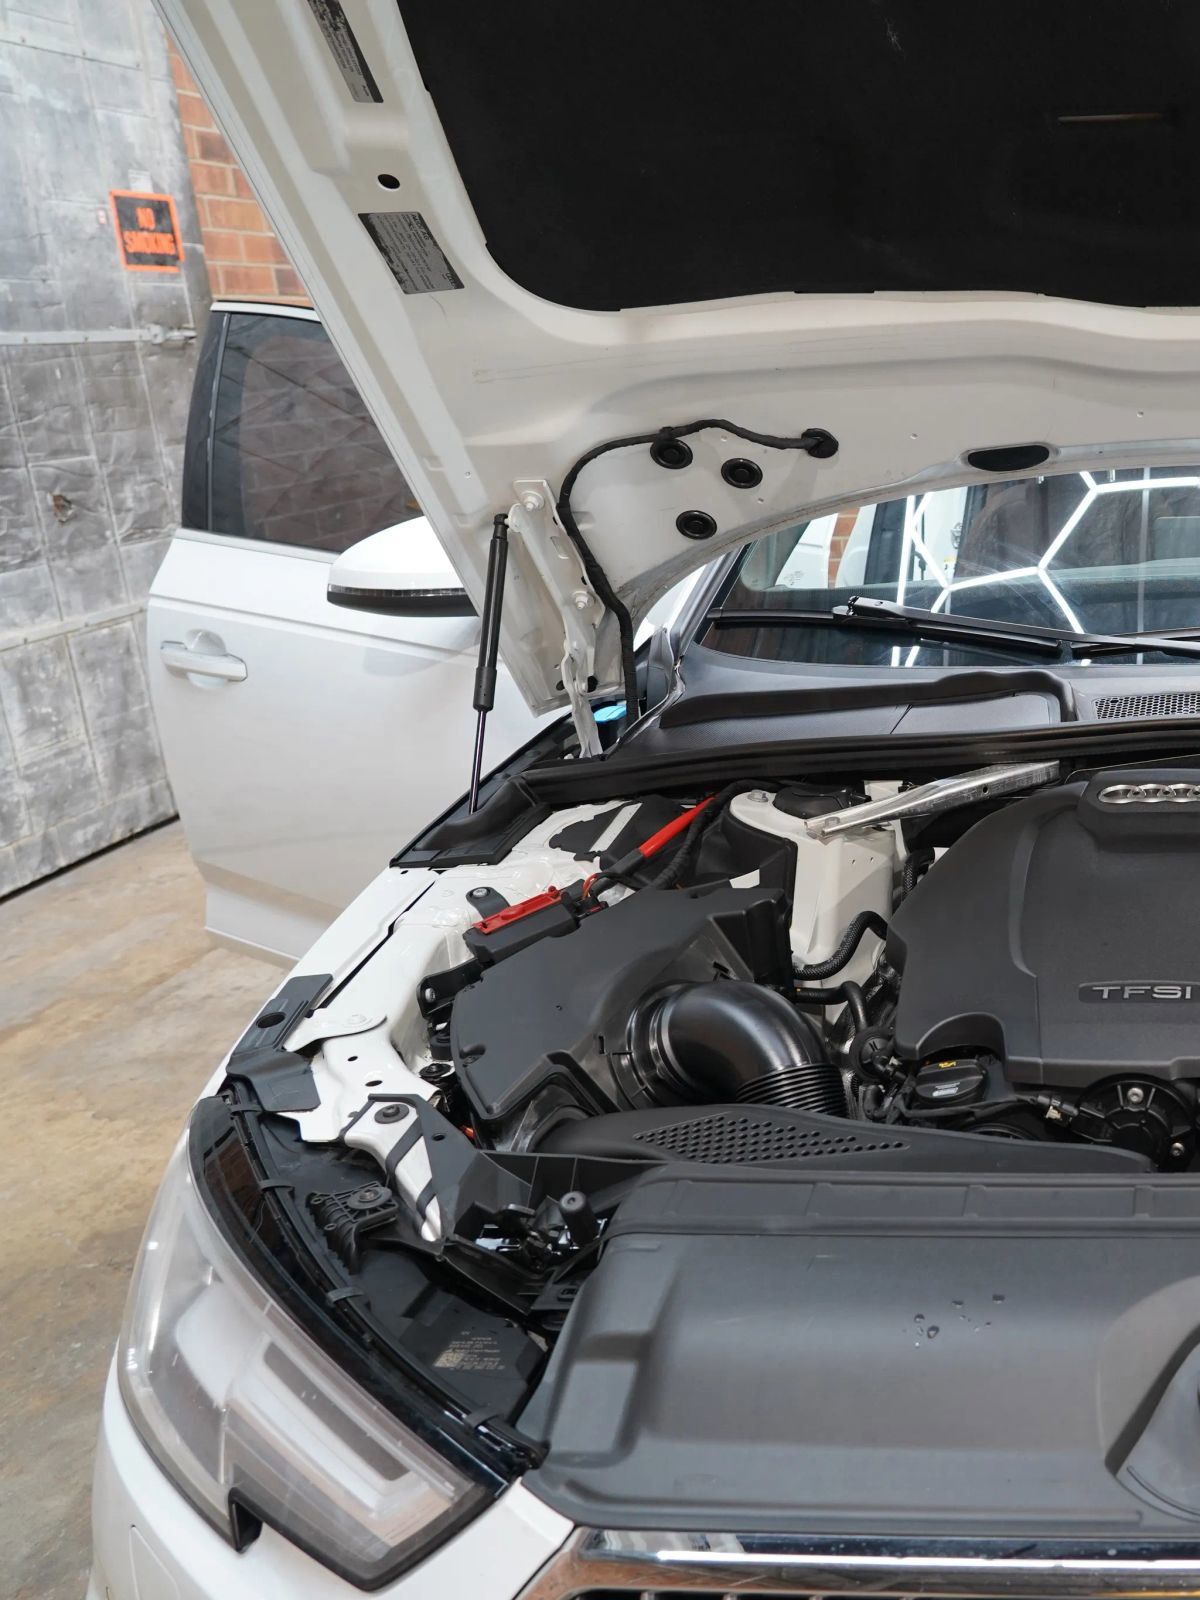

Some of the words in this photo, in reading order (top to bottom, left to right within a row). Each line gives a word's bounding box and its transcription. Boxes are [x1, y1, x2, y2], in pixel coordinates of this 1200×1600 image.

[136, 207, 156, 230] NO
[123, 231, 176, 255] SMOKING
[1092, 985, 1192, 999] TFSI
